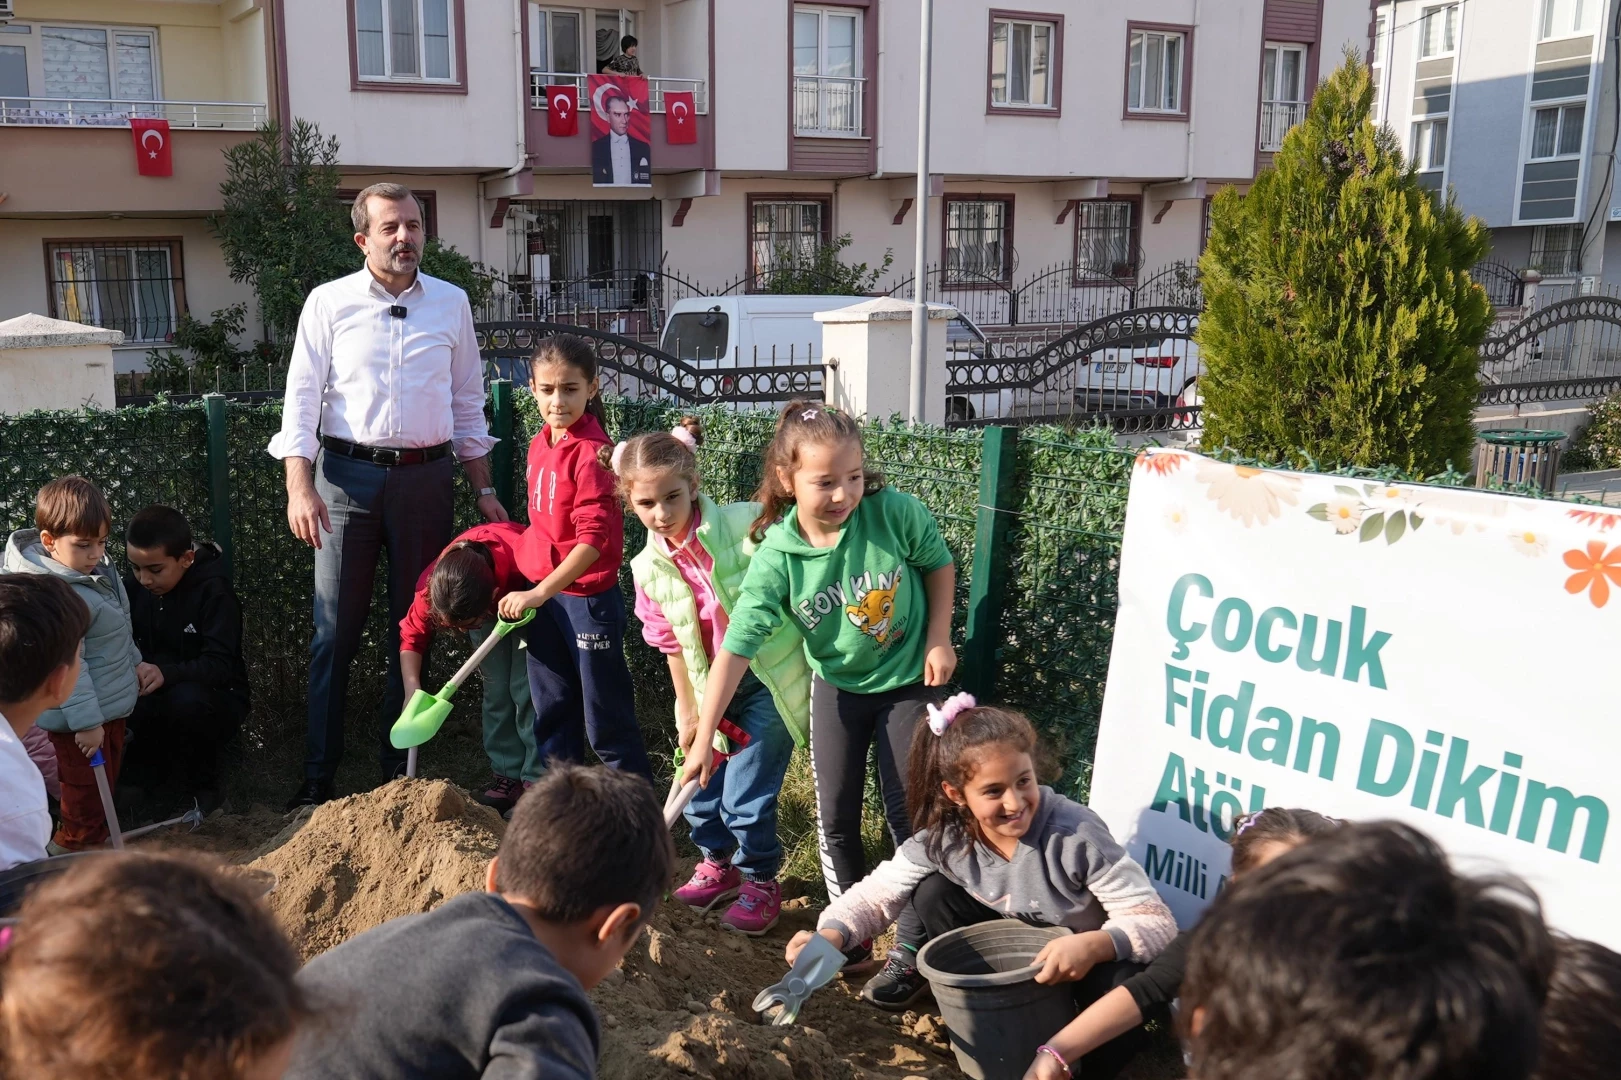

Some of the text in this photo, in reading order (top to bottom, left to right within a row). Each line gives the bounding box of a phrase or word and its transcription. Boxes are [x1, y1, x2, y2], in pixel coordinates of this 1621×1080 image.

[850, 564, 902, 602] KIN
[1166, 572, 1393, 691] Çocuk
[1165, 662, 1610, 864] Fidan Dikim
[1144, 843, 1208, 900] Milli
